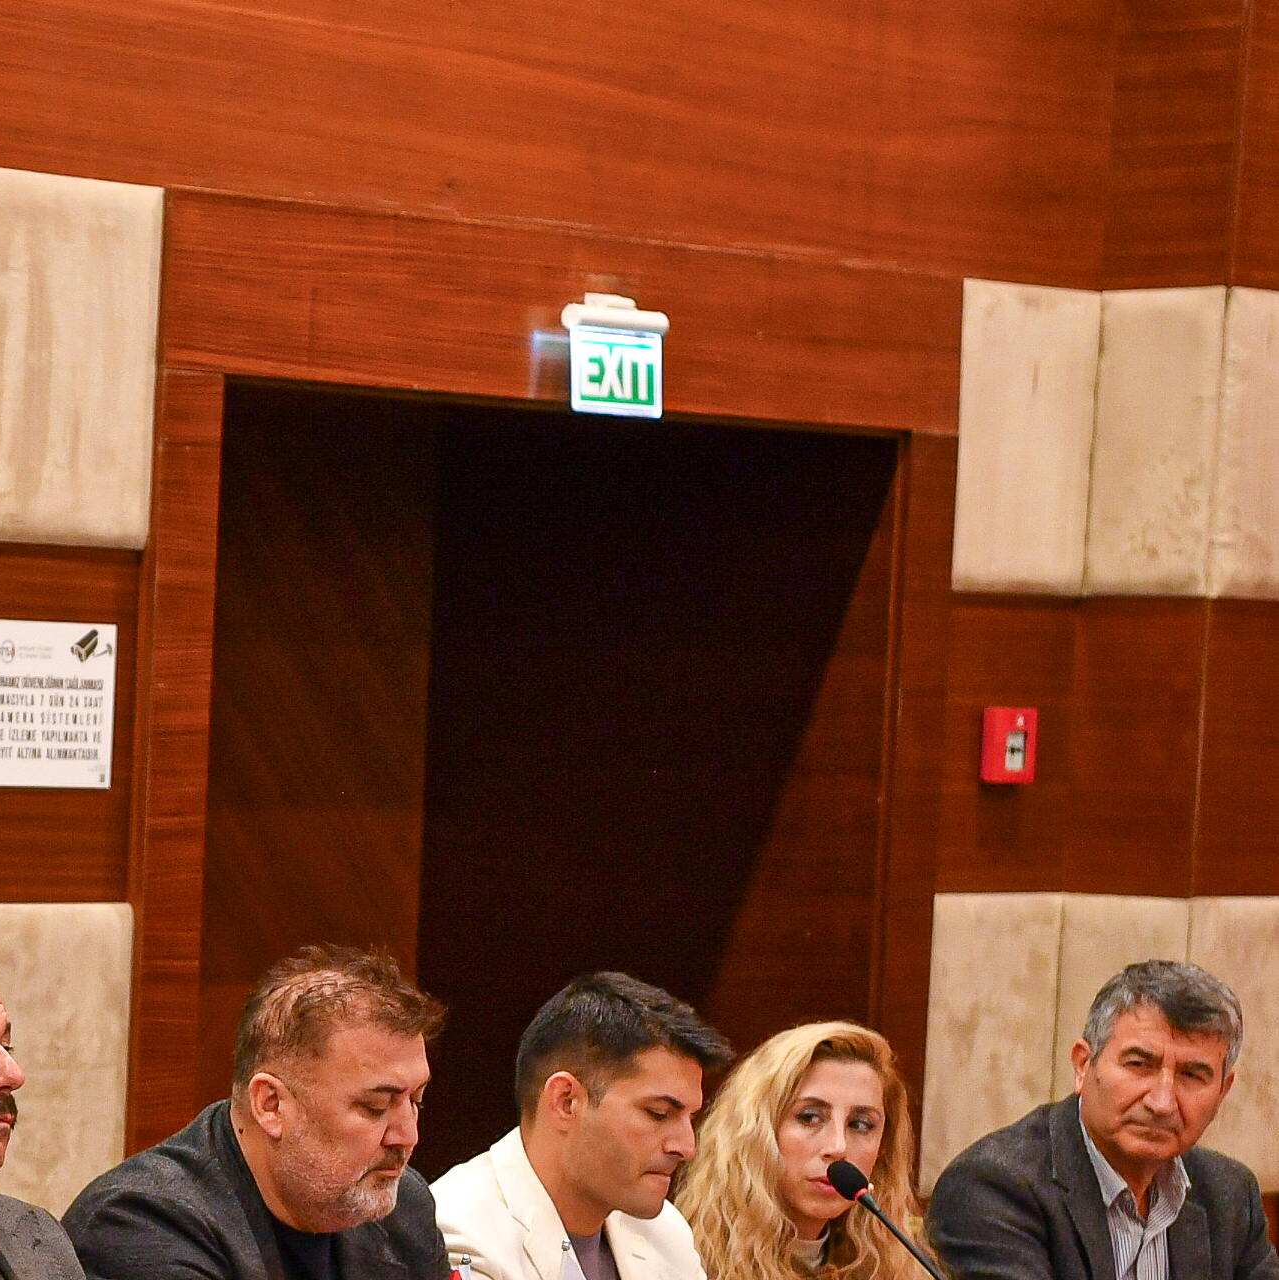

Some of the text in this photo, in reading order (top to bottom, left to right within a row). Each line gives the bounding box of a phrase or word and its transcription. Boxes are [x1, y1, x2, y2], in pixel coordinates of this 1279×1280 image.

[581, 344, 652, 400] EXIT
[40, 694, 45, 706] 7
[49, 692, 65, 708] GÜN
[69, 695, 79, 708] 24
[84, 696, 103, 709] SAAT
[40, 710, 103, 726] SİSTEMLERİ
[8, 728, 37, 742] İZLEME
[41, 729, 88, 743] YAPILMAKTA
[93, 731, 102, 744] VE
[17, 747, 42, 759] ALTINA
